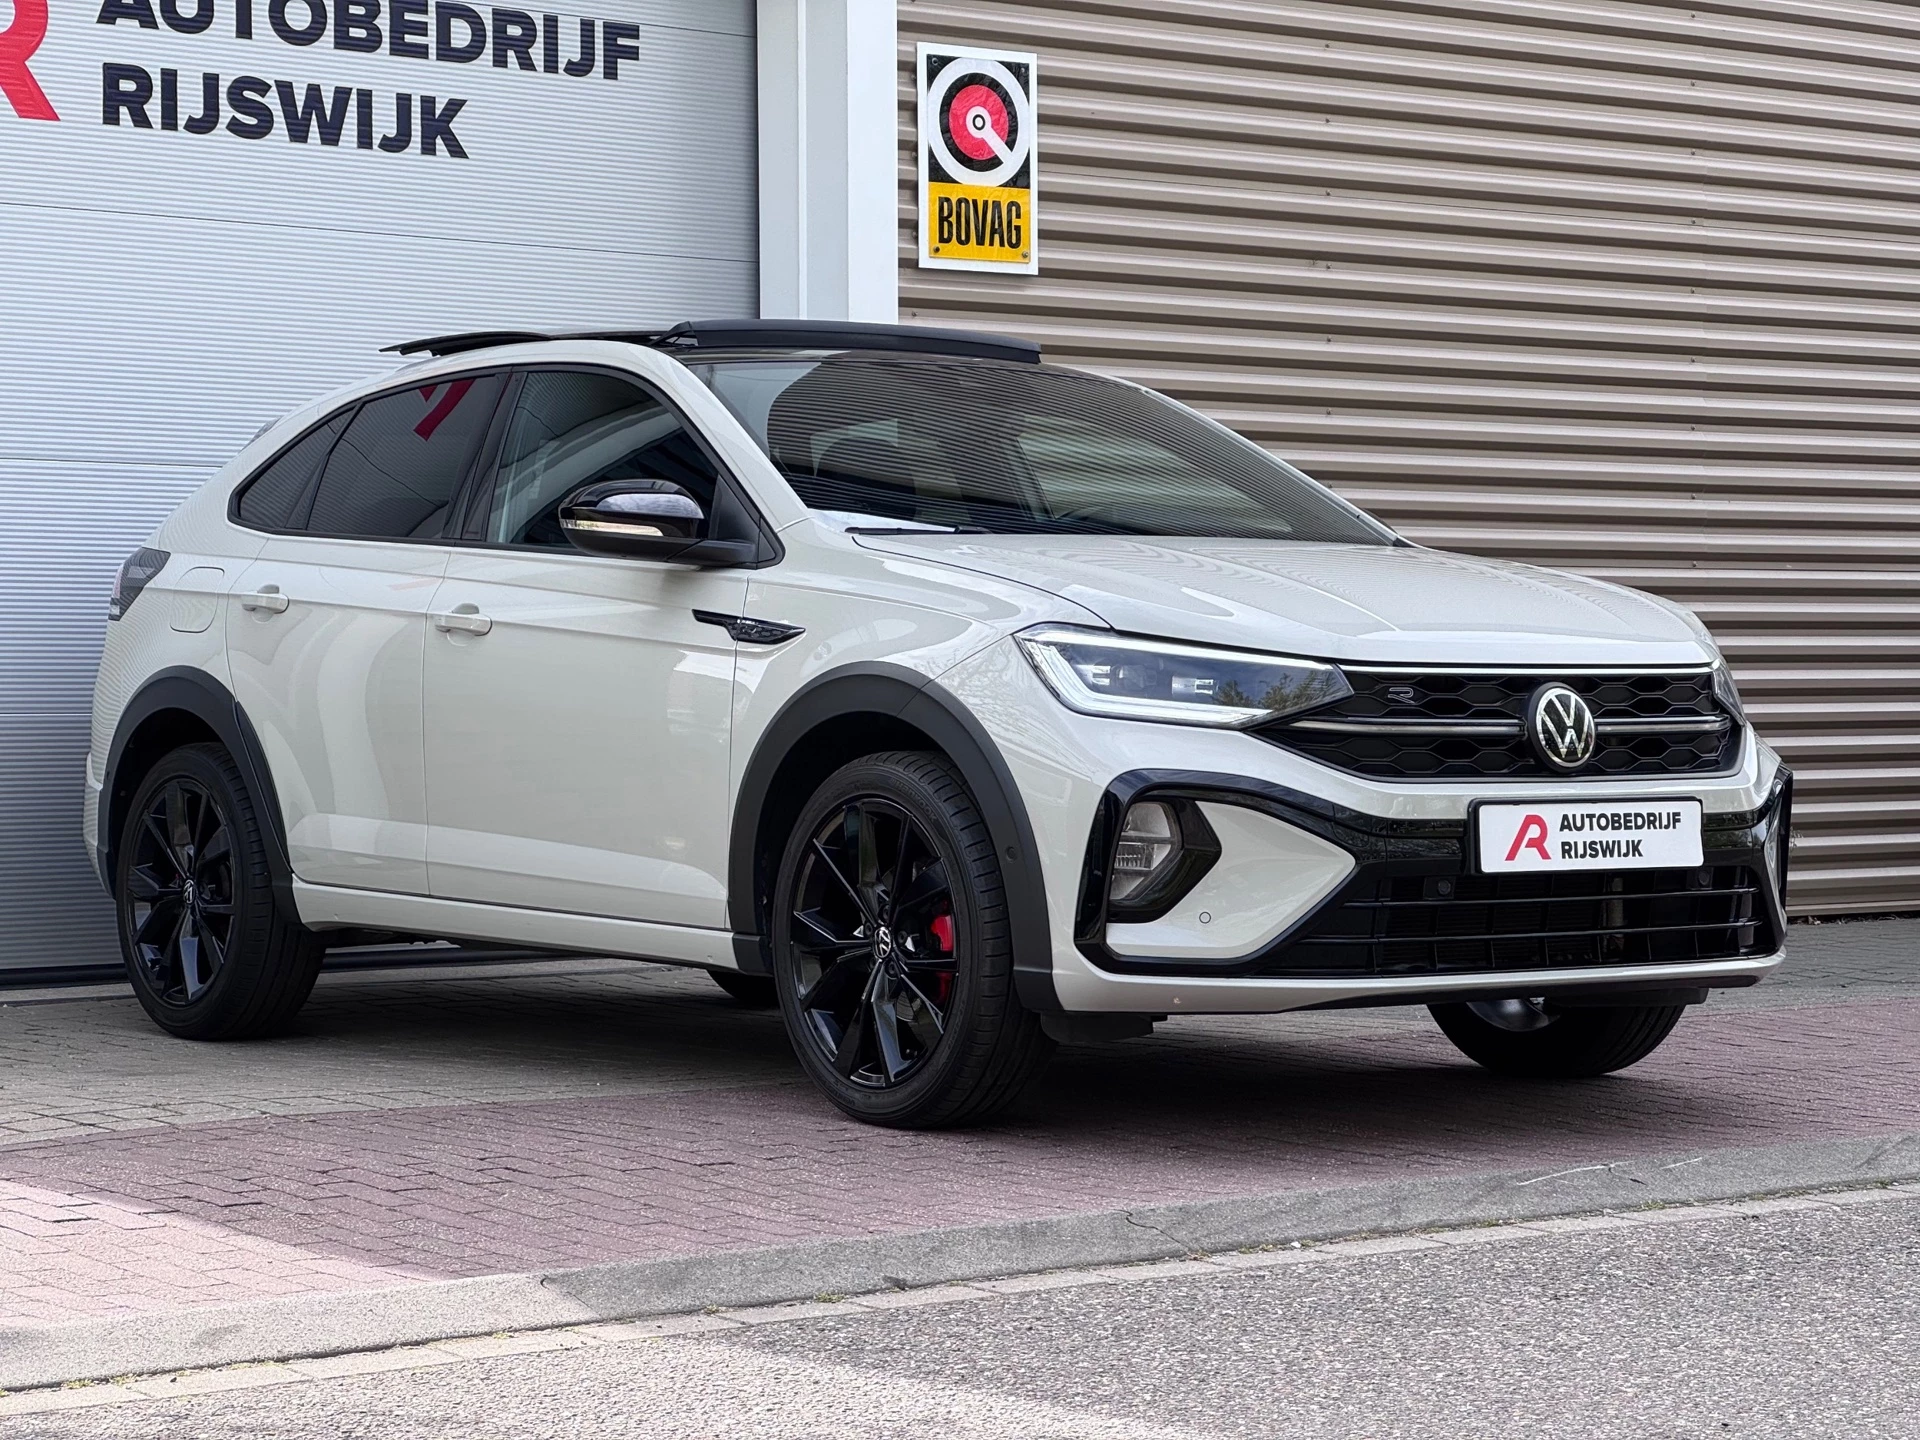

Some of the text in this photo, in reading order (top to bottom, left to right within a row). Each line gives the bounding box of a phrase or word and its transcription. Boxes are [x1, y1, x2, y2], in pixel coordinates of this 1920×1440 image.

[102, 62, 469, 159] RIJSWIJK
[938, 196, 1022, 249] BOVAG
[1559, 811, 1682, 832] AUTOBEDRIJF
[1560, 839, 1643, 860] RIJSWIJK
